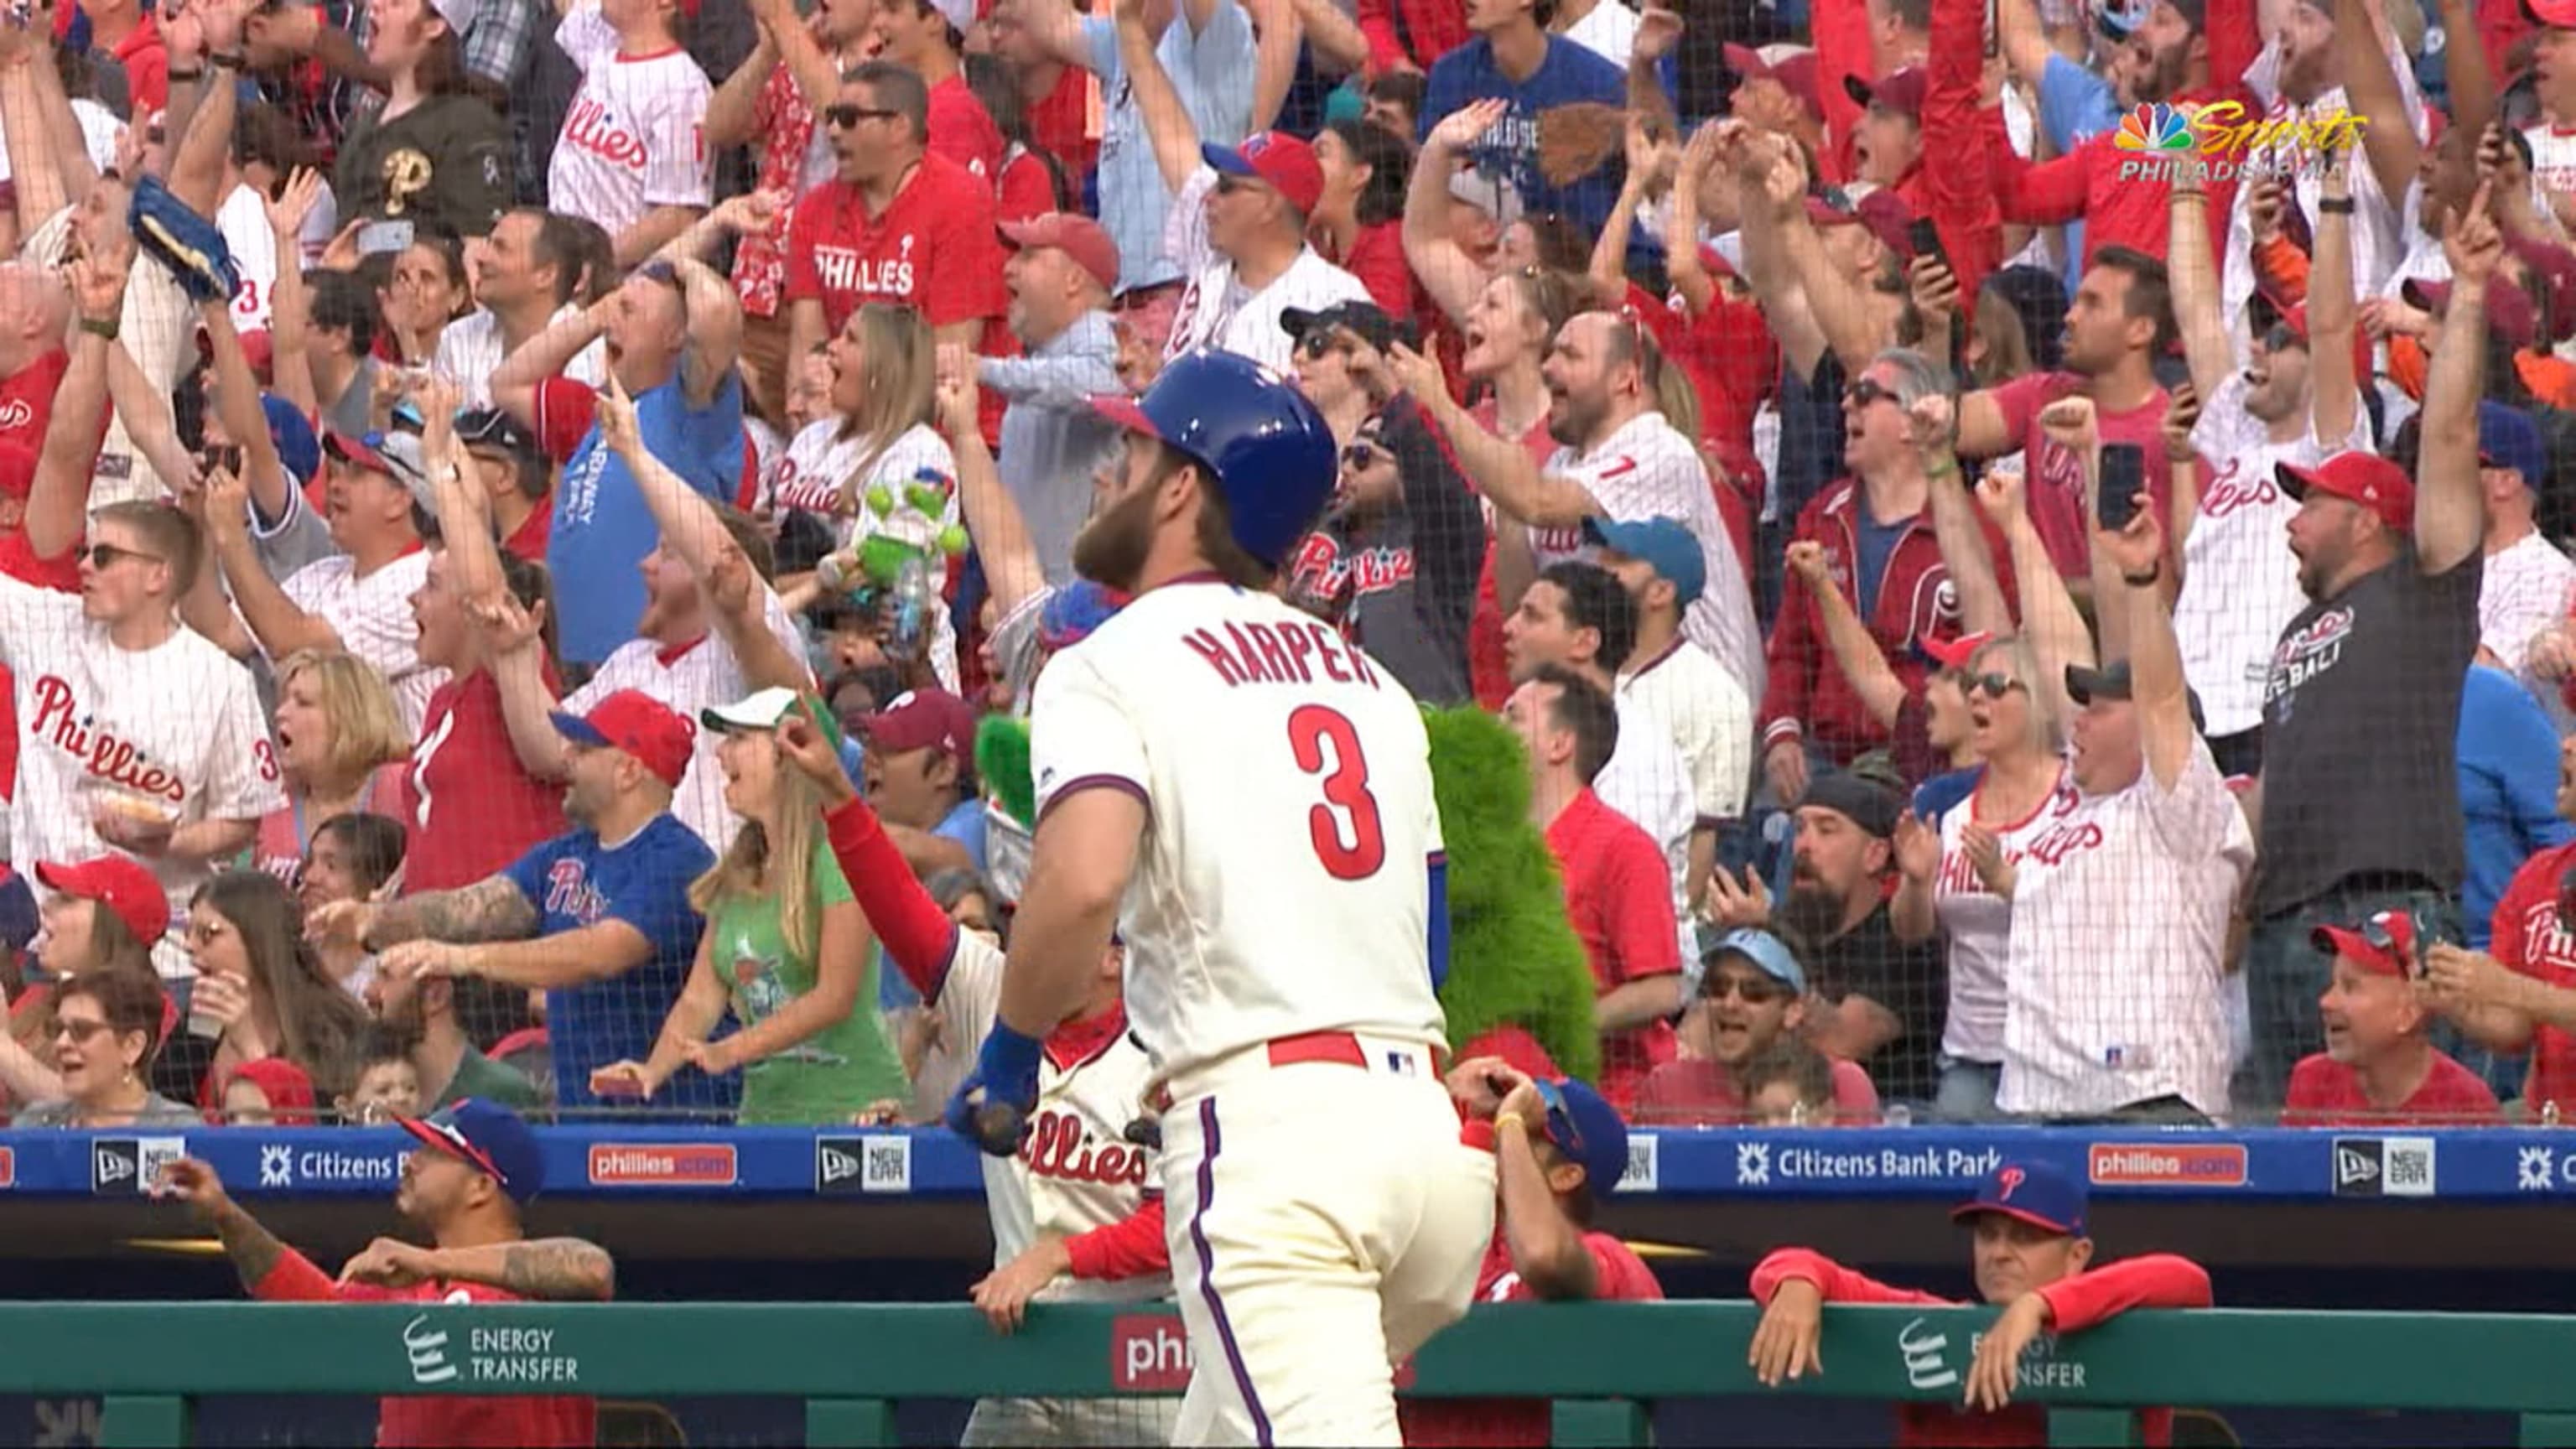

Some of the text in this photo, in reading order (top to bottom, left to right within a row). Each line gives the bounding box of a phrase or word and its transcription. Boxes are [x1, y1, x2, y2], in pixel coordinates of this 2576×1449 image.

[32, 675, 184, 802] Phillies
[254, 739, 278, 782] 3
[1287, 704, 1386, 881] 3
[300, 1151, 392, 1179] Citizens
[1779, 1145, 2002, 1177] Citizens Bank Park
[470, 1328, 554, 1353] ENERGY
[470, 1357, 579, 1382] TRANSFER
